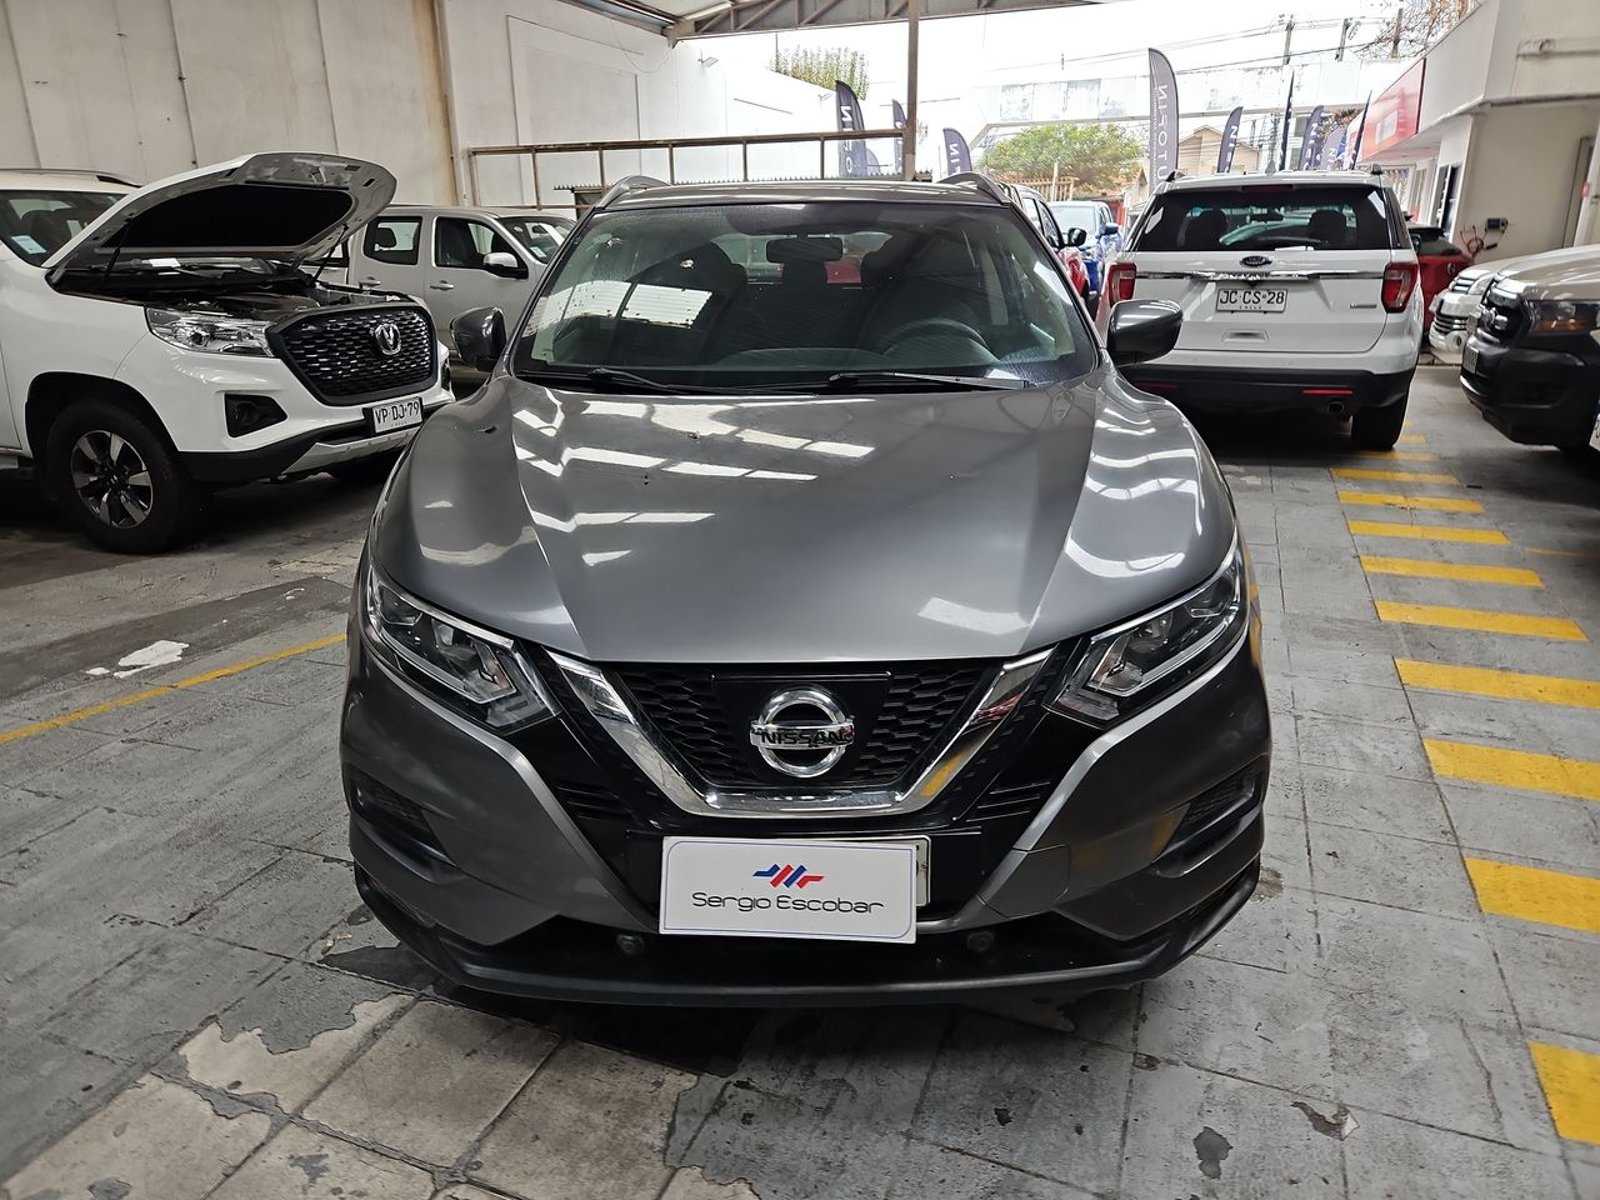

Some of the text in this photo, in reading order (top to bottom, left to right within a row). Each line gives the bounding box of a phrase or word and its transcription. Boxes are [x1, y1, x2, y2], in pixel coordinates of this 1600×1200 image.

[761, 729, 845, 745] NISSAN
[692, 892, 884, 913] Sergio Escobar
